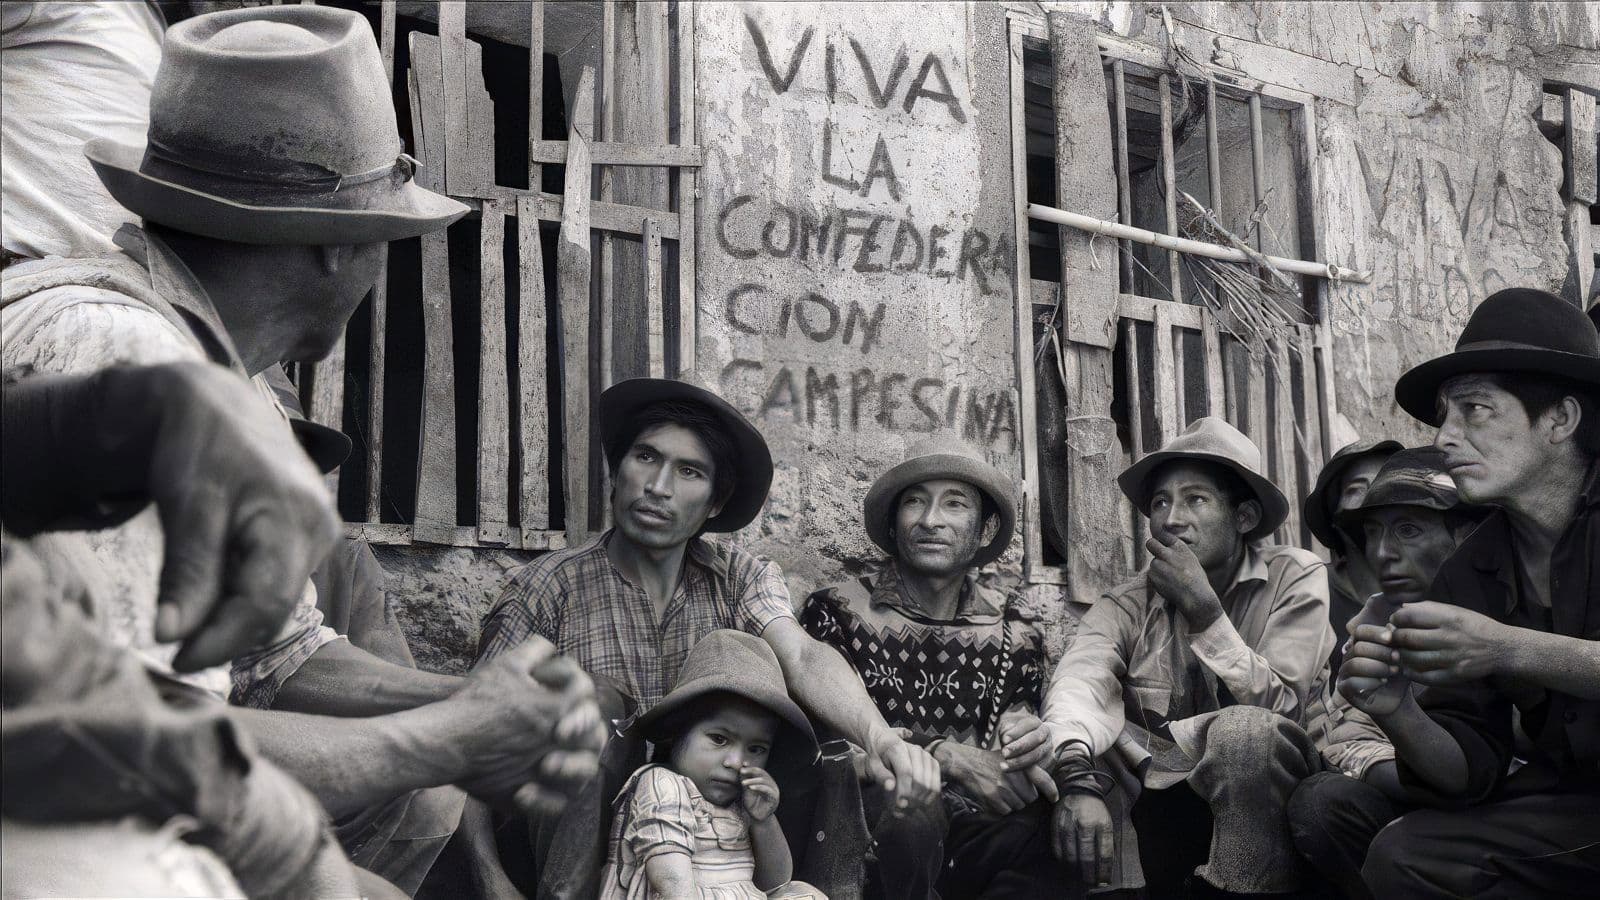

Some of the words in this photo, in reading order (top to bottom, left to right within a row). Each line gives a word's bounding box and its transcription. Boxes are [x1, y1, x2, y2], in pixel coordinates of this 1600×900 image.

[744, 13, 967, 124] VIVA
[822, 117, 901, 202] LA
[725, 283, 886, 353] CION
